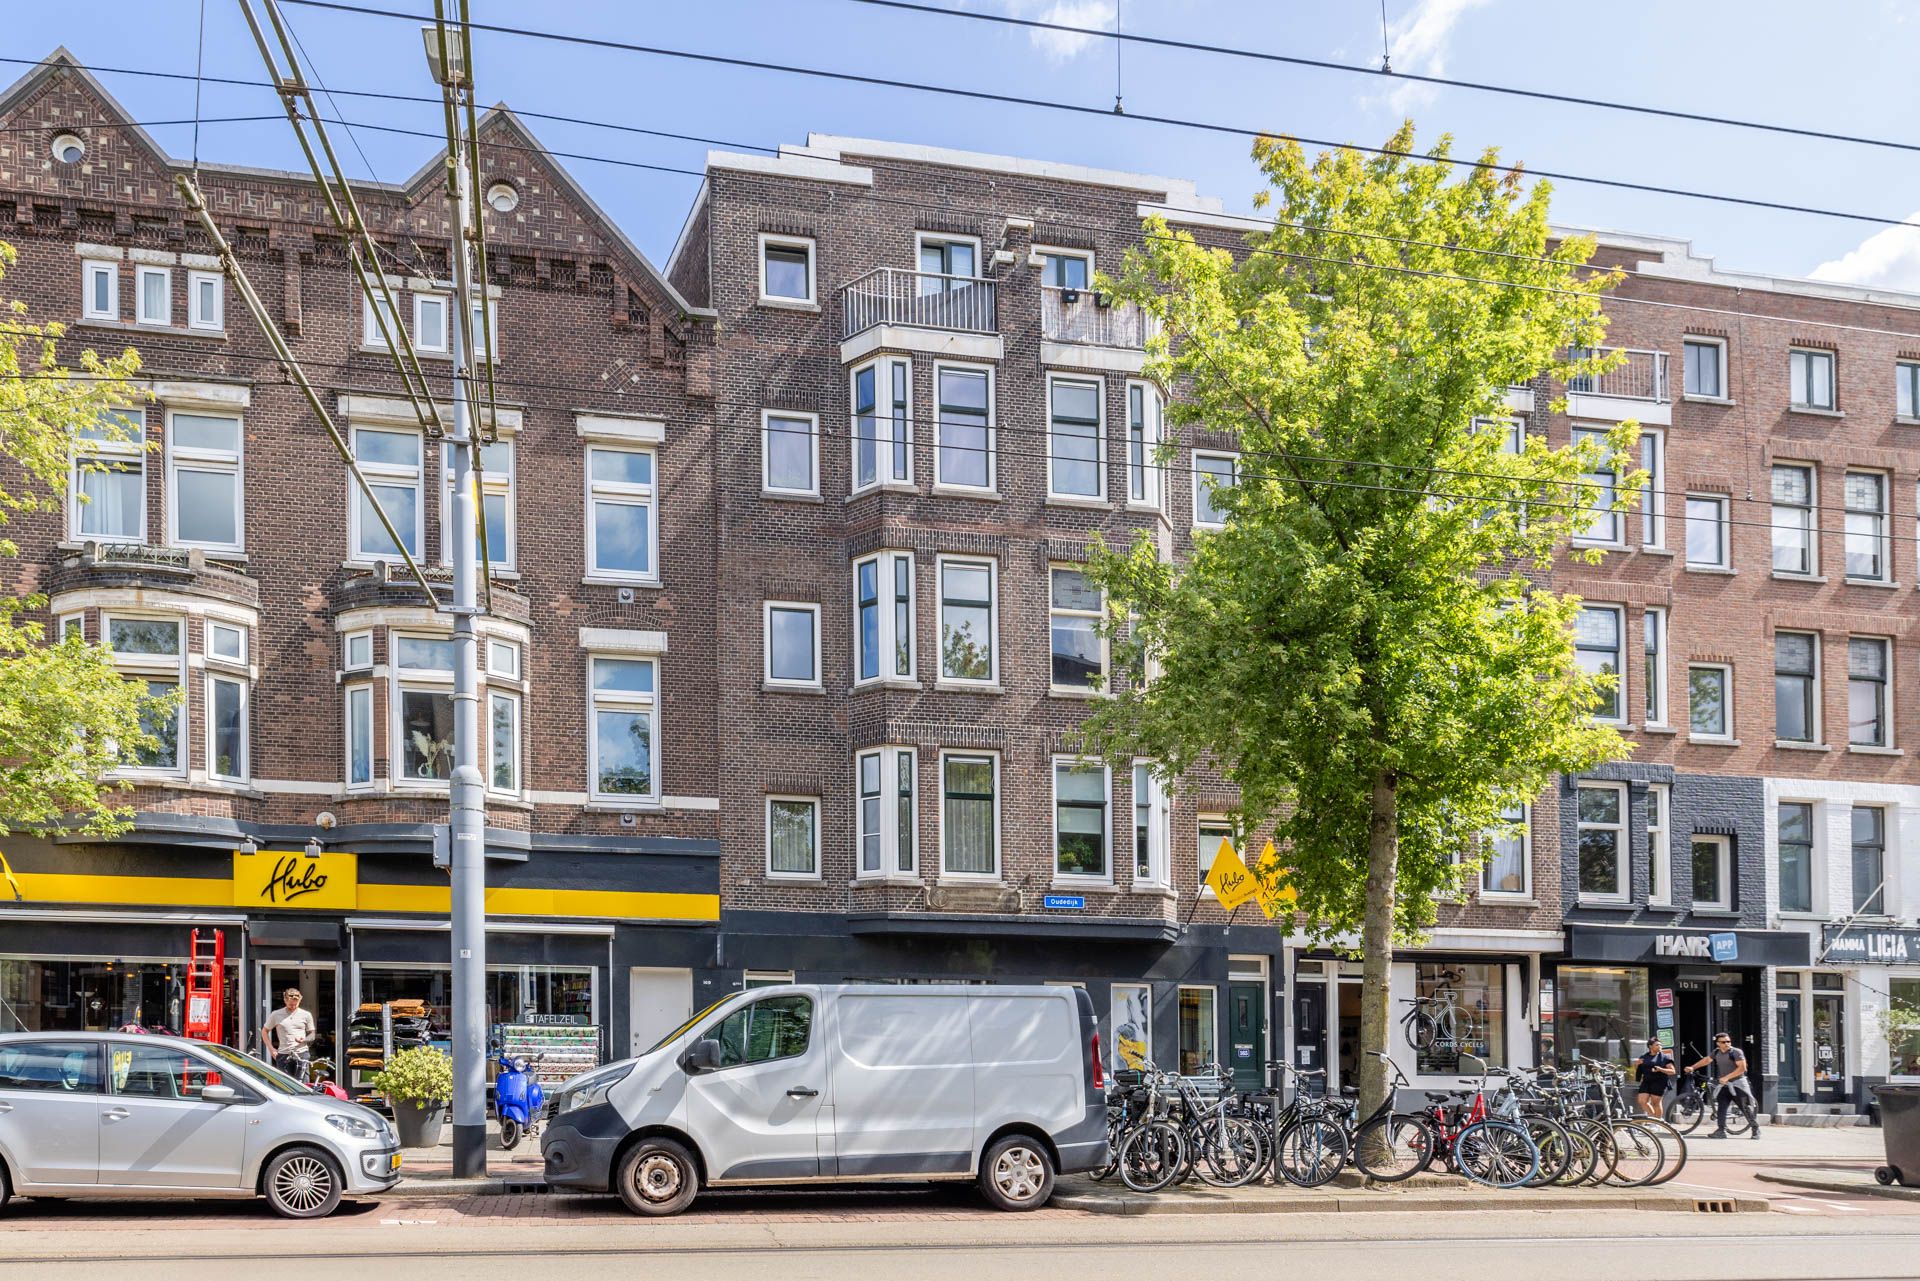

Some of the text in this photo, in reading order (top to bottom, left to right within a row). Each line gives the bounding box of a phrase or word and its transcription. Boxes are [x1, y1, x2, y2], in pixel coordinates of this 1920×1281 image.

[261, 856, 328, 902] Hubo
[1220, 872, 1244, 895] Hubo
[1260, 874, 1280, 900] Hub
[1050, 896, 1078, 906] Oudedijk
[1656, 934, 1733, 957] HAIR APP
[1832, 938, 1865, 951] MAMMA
[1867, 933, 1908, 958] LICIA
[535, 1014, 578, 1025] TAFELZEIL
